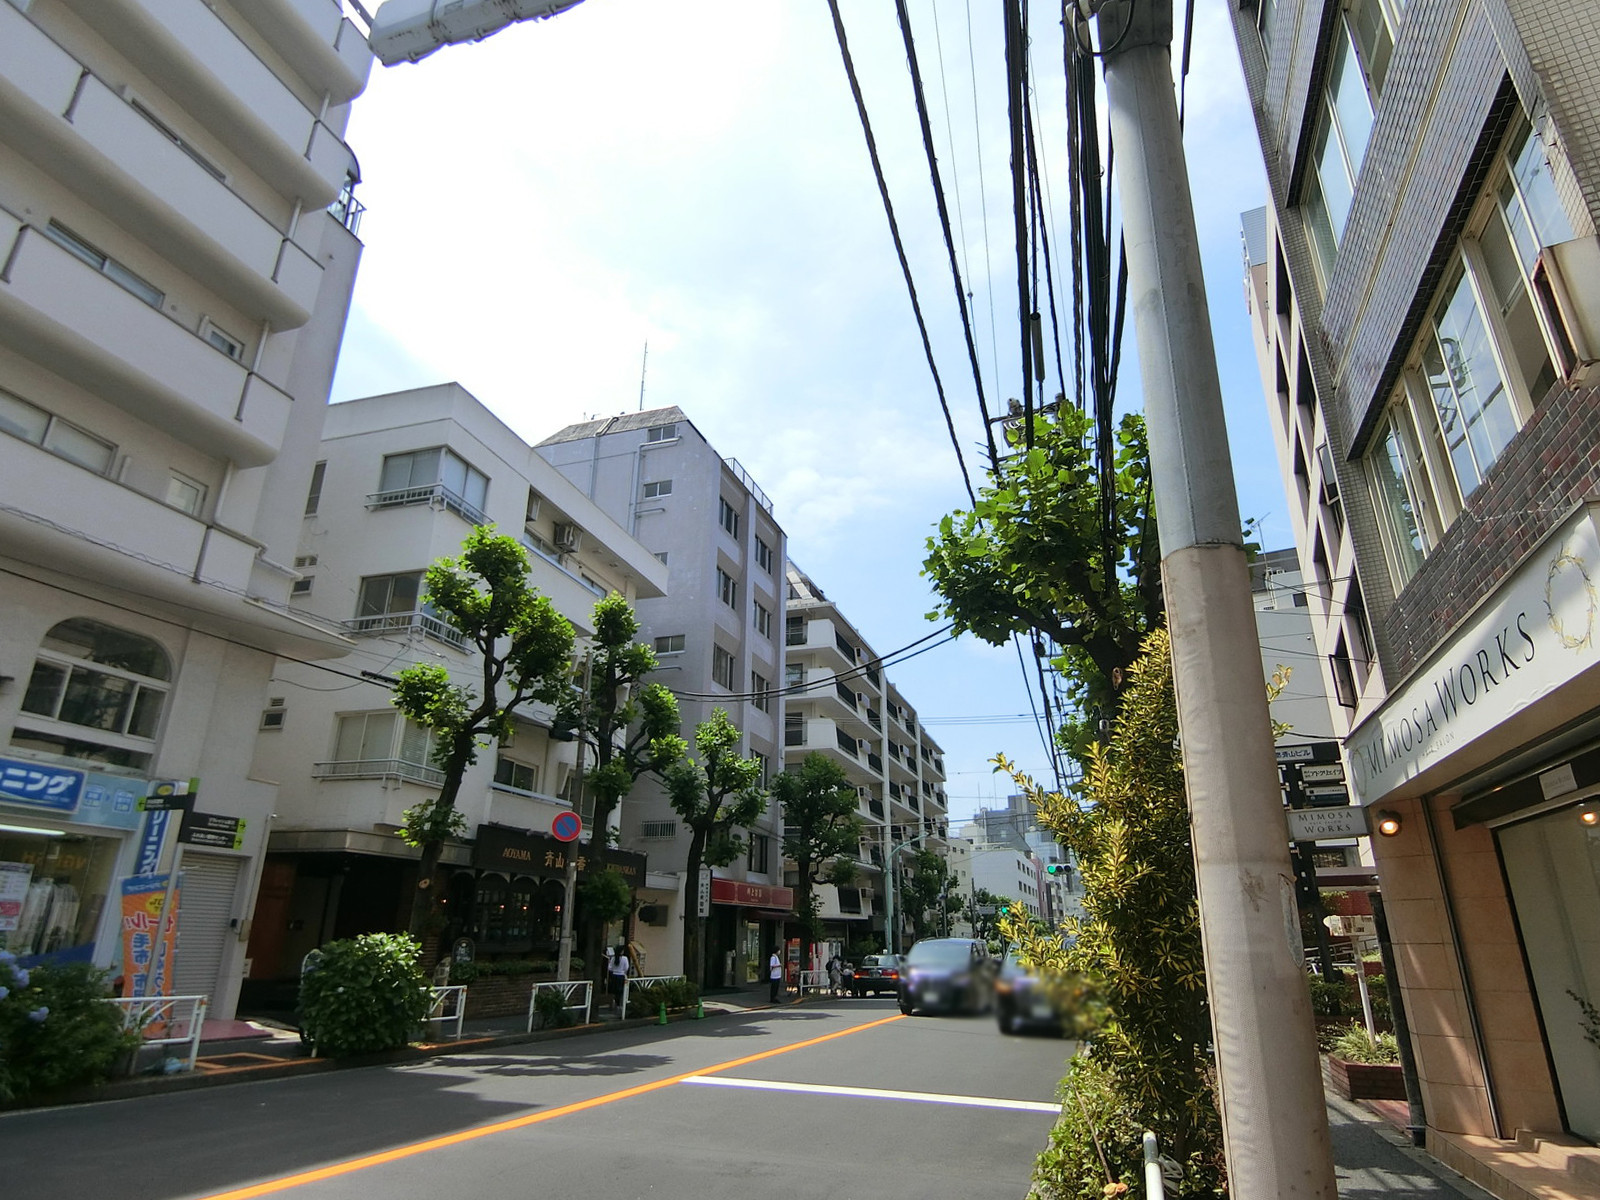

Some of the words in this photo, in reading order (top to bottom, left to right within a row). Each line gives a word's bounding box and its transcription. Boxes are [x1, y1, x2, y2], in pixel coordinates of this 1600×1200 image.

[1368, 699, 1438, 779] MIMOSA
[1435, 612, 1536, 723] WORKS
[0, 768, 76, 794] ニング
[1298, 811, 1352, 822] MIMOSA
[1304, 824, 1351, 834] WORKS
[140, 810, 165, 873] リーニング
[502, 848, 531, 861] AOYAMA
